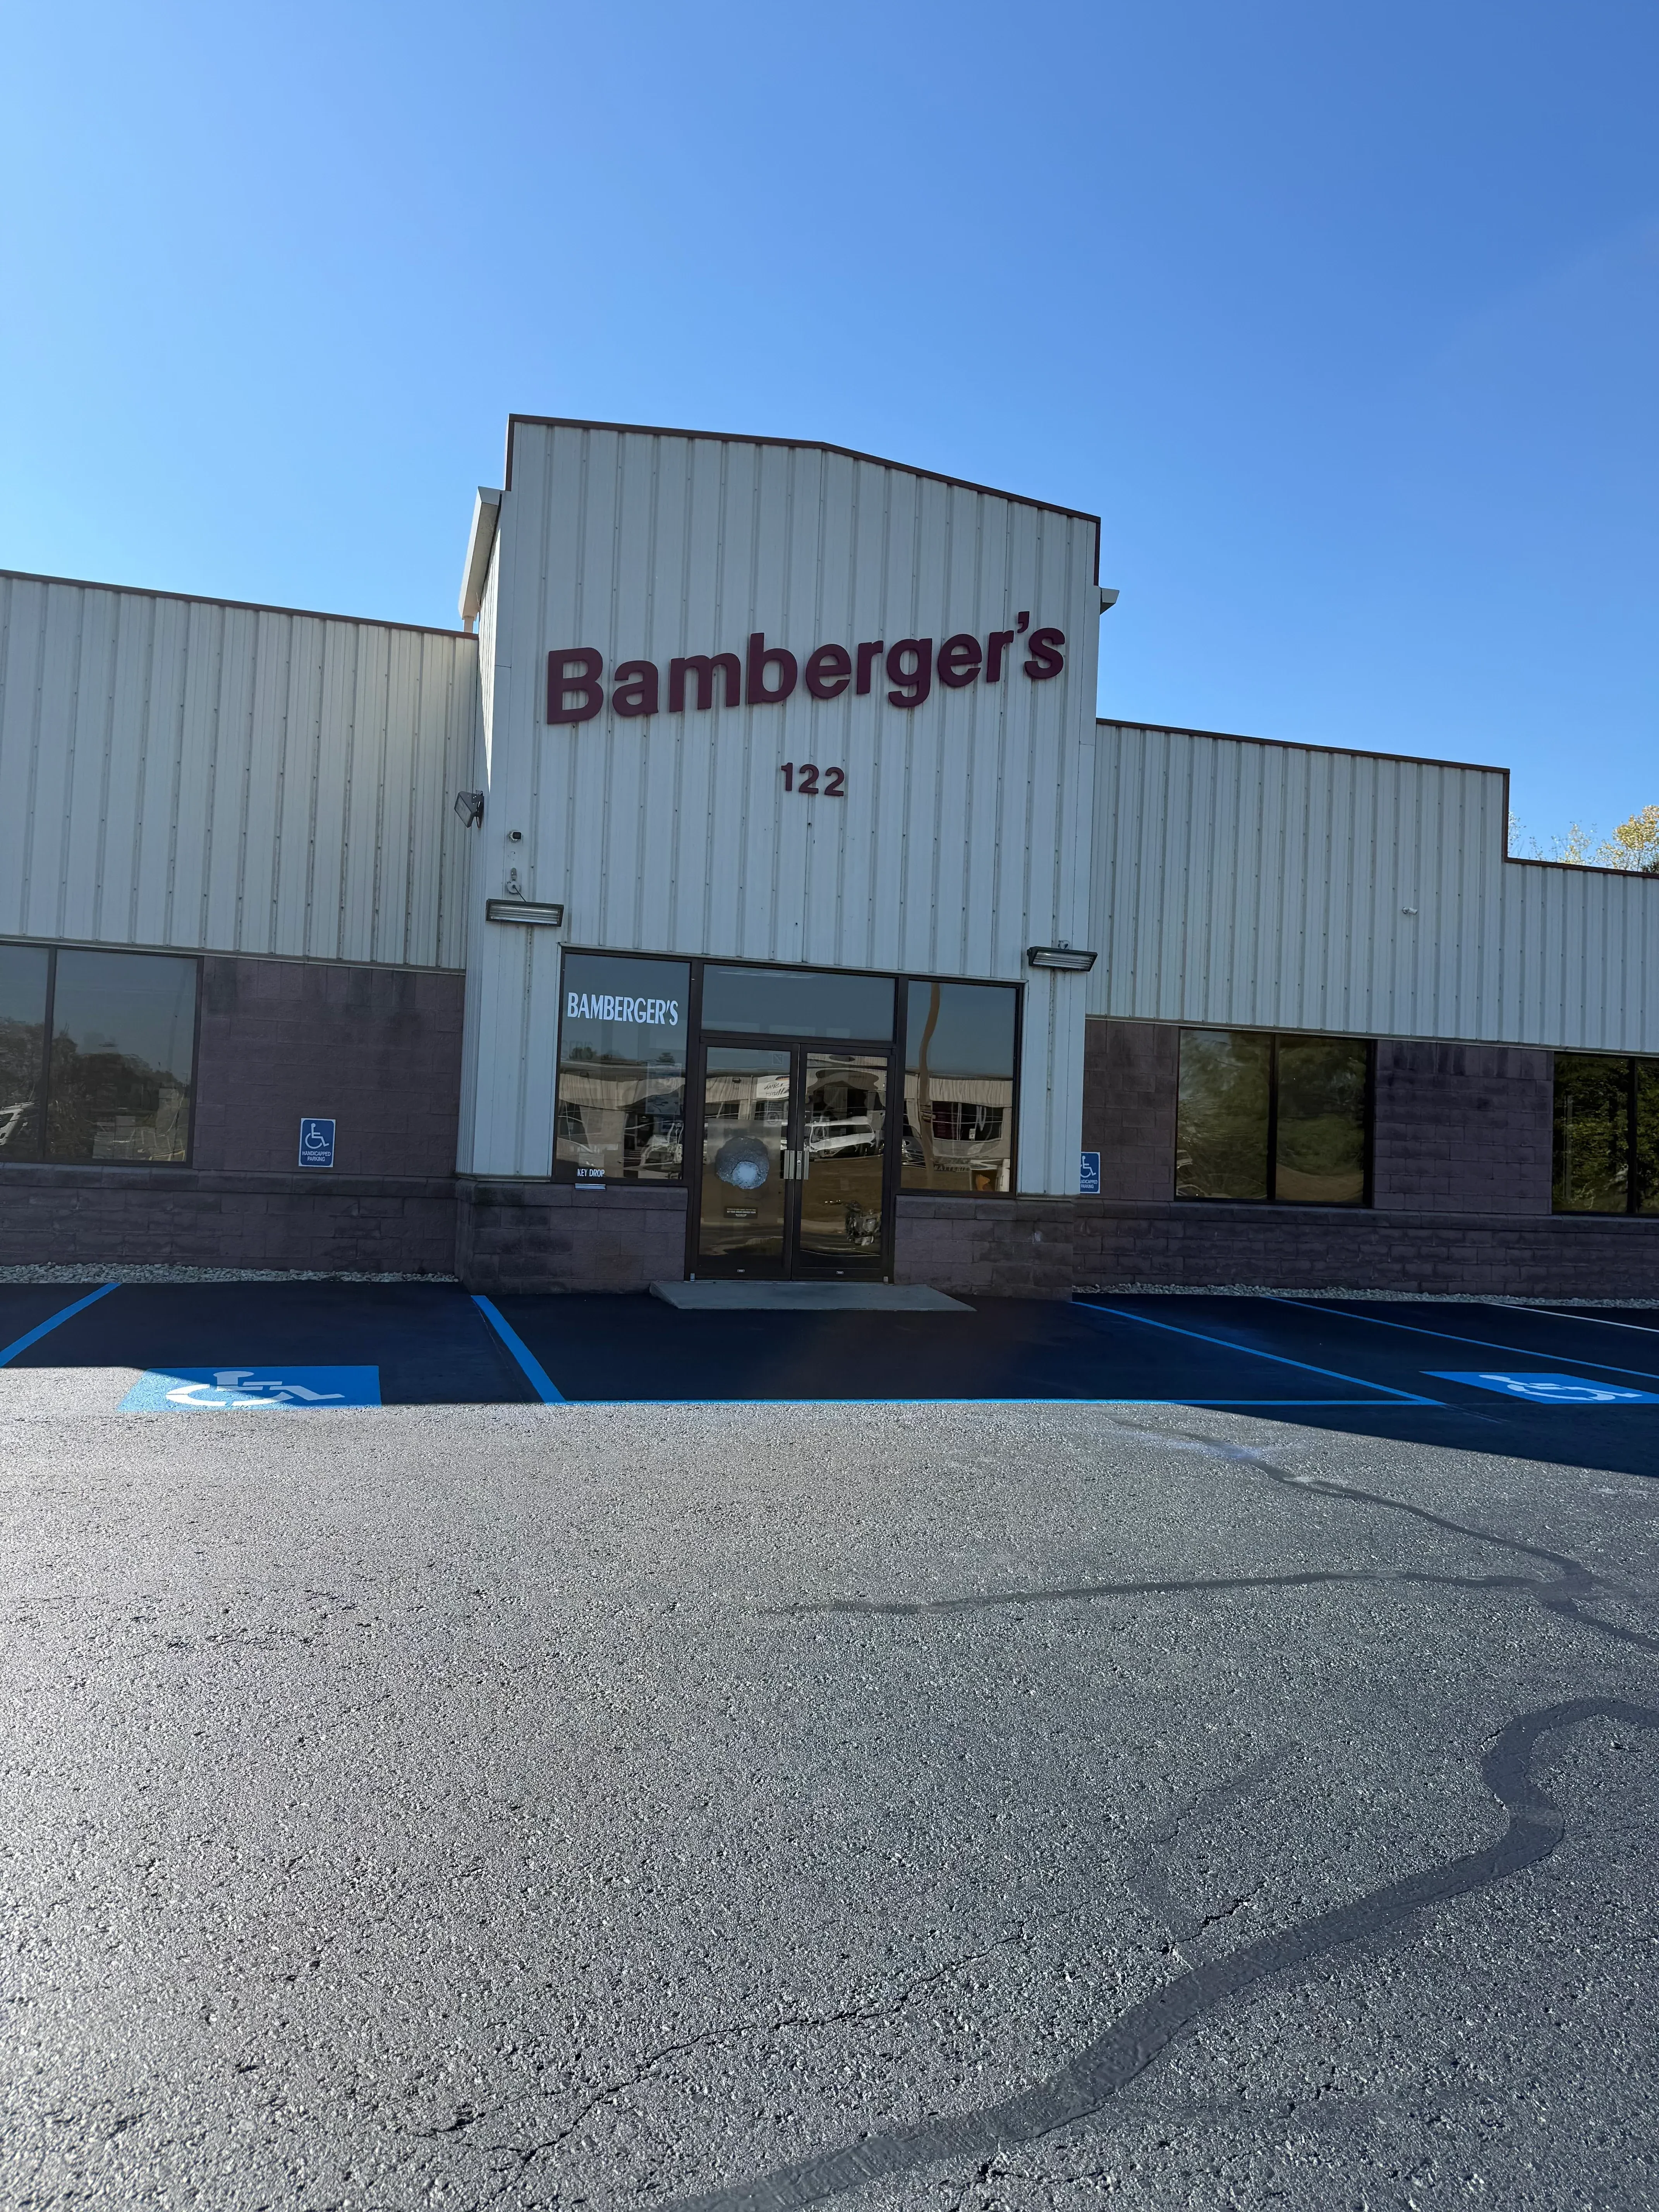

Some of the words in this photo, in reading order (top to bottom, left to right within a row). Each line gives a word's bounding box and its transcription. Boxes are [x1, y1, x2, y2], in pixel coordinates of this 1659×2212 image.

[547, 611, 1065, 725] Bamberger's
[781, 762, 845, 796] 122
[567, 992, 678, 1026] BAMBERGER'S
